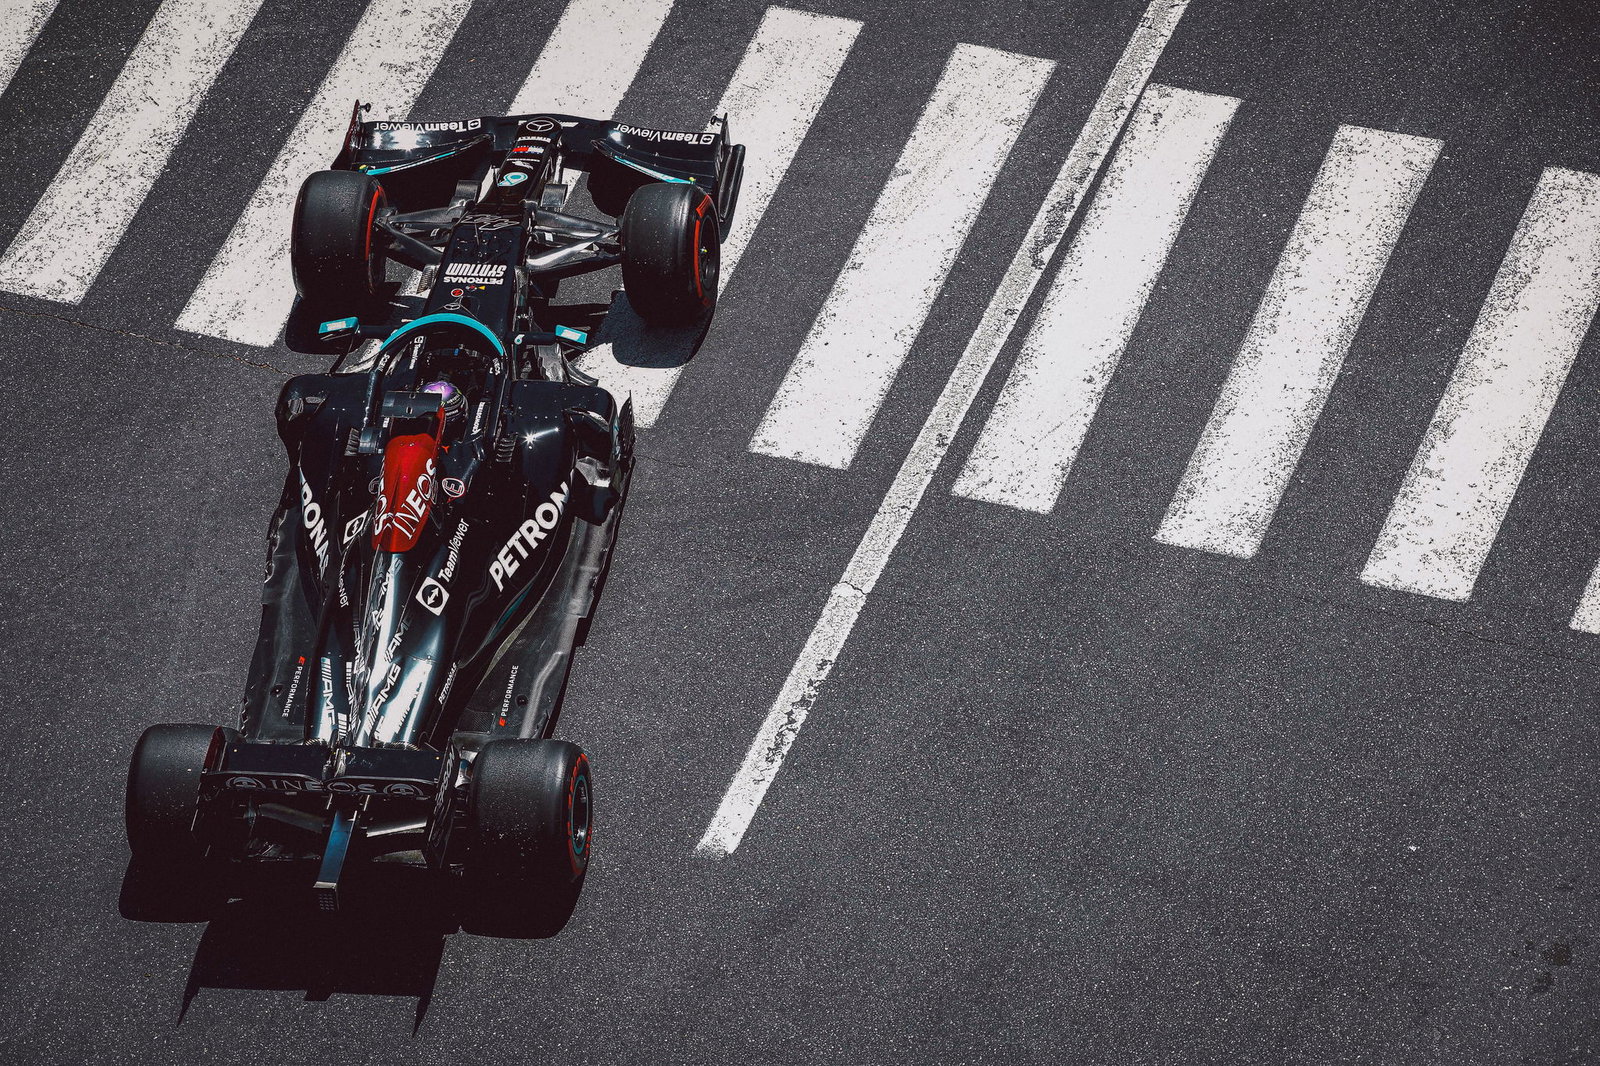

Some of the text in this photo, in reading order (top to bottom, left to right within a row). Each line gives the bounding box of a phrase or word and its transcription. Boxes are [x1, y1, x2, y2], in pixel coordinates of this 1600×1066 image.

[374, 121, 467, 133] TeamViewer
[614, 123, 700, 144] TeamViewer
[445, 262, 507, 277] SYNTIUM
[443, 276, 504, 285] PETRONAS
[438, 518, 470, 582] TeamViewer
[282, 666, 303, 718] PERFORMANCE
[501, 665, 519, 717] PERFORMANCE
[271, 778, 378, 794] INEOS
